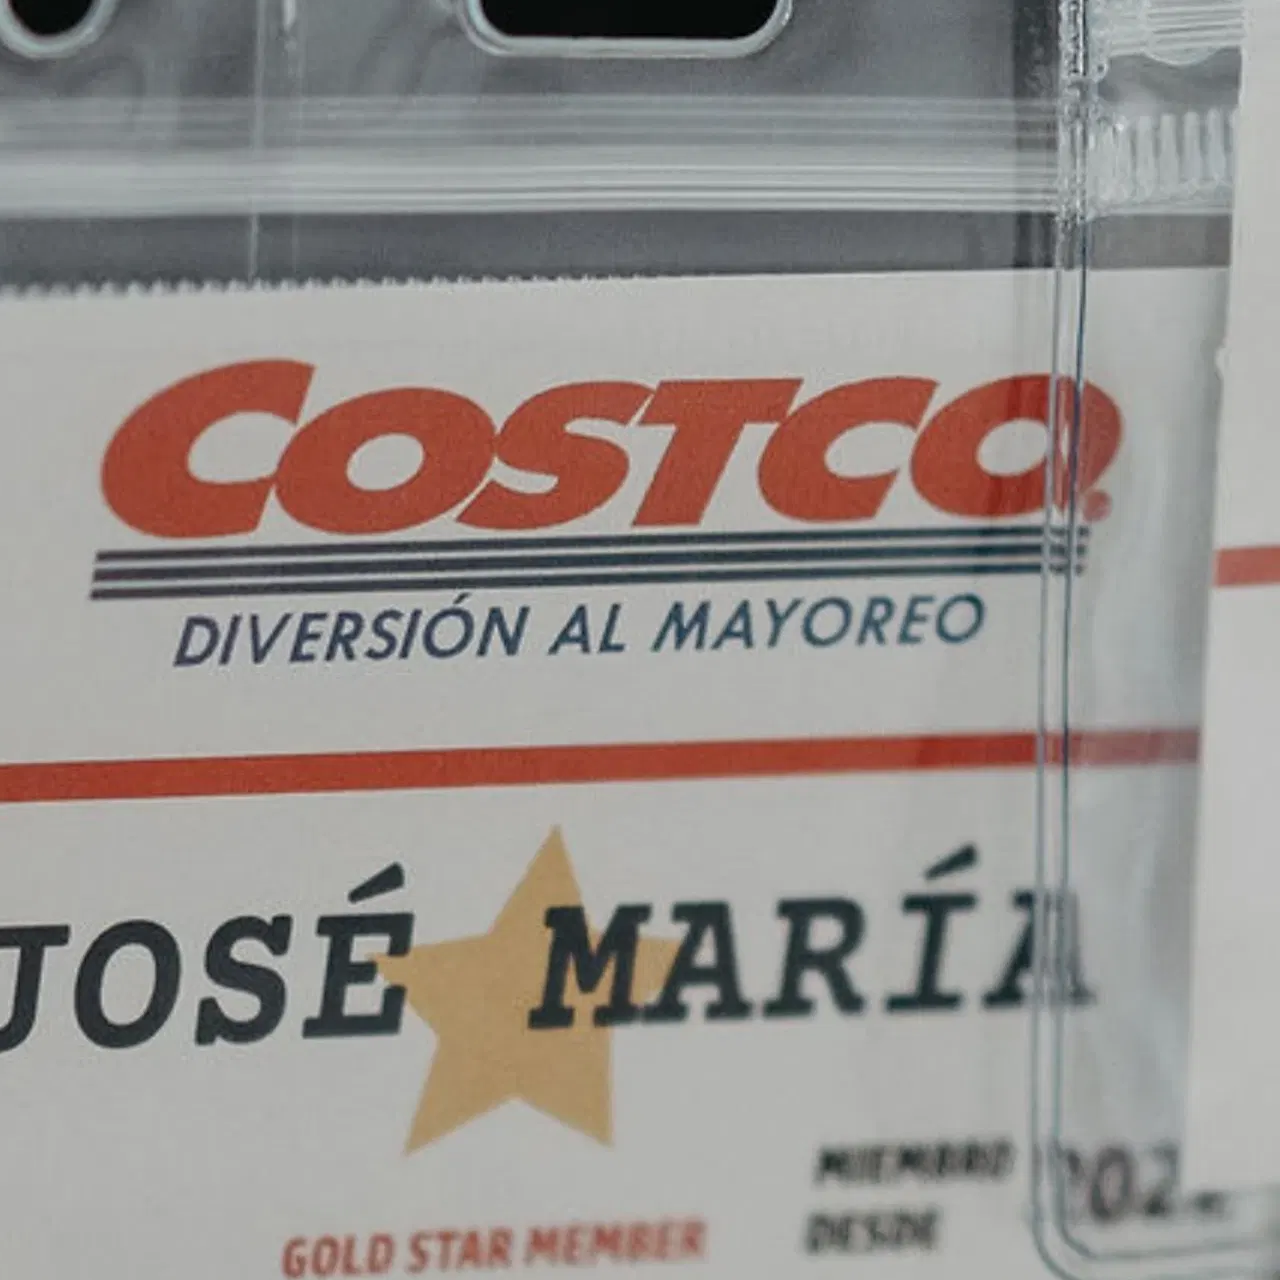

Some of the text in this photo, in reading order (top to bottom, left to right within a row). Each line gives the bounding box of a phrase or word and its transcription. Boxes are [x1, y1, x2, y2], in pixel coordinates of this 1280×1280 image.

[100, 358, 1122, 540] COSTCO
[174, 592, 986, 668] DIVERSIÓN AL MAYOREO
[526, 843, 1096, 1032] MARÍA
[280, 1218, 706, 1280] GOLD STAR MEMBER
